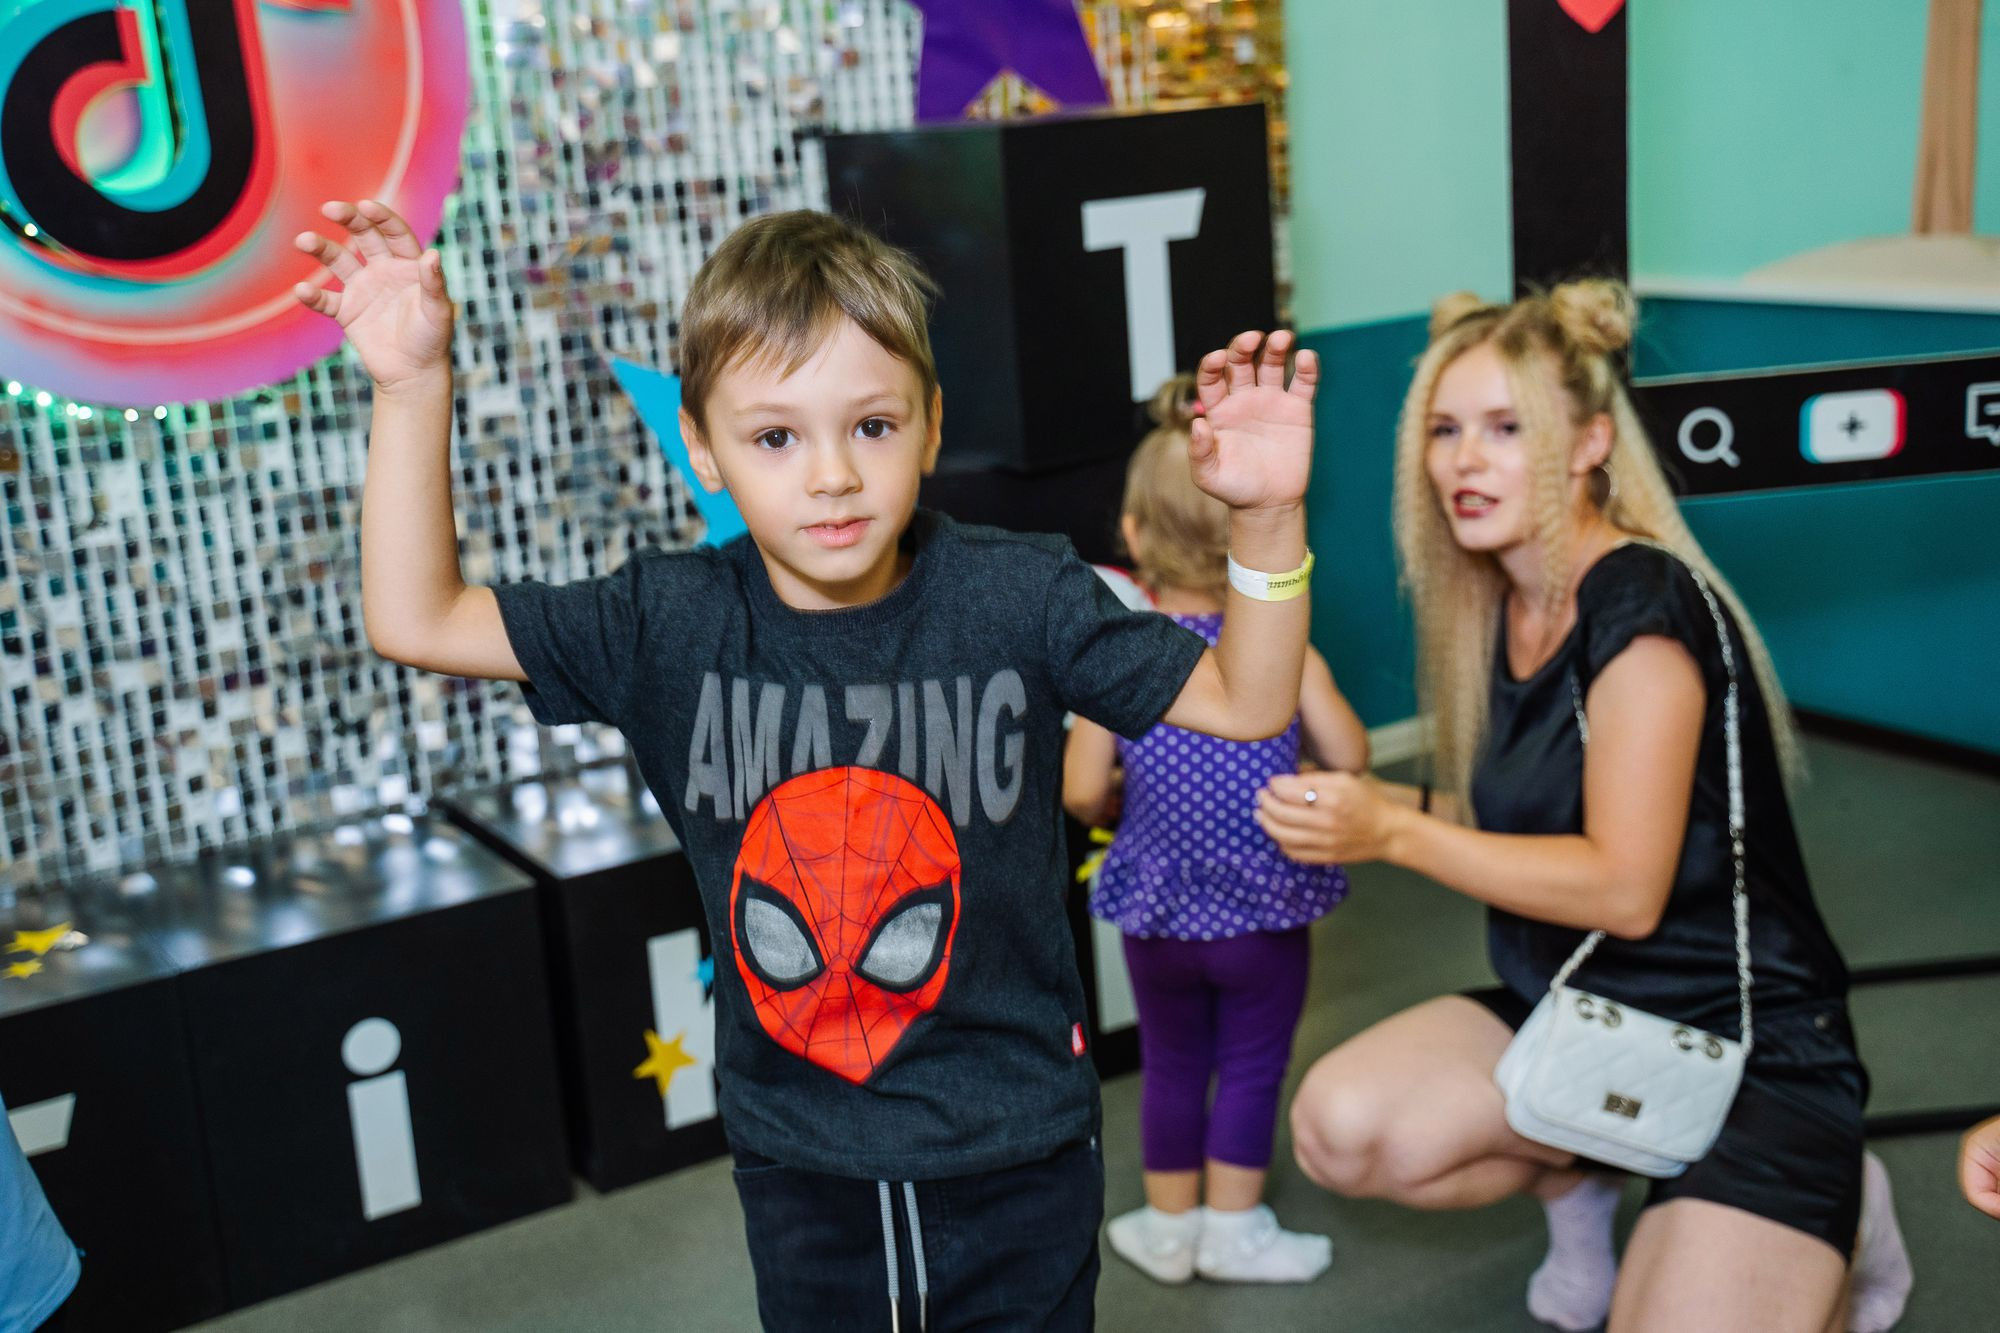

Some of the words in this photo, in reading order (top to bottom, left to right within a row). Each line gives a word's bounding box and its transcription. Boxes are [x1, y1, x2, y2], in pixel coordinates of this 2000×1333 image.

[1081, 188, 1206, 402] T
[684, 668, 1027, 827] AMAZING
[341, 1016, 422, 1222] i
